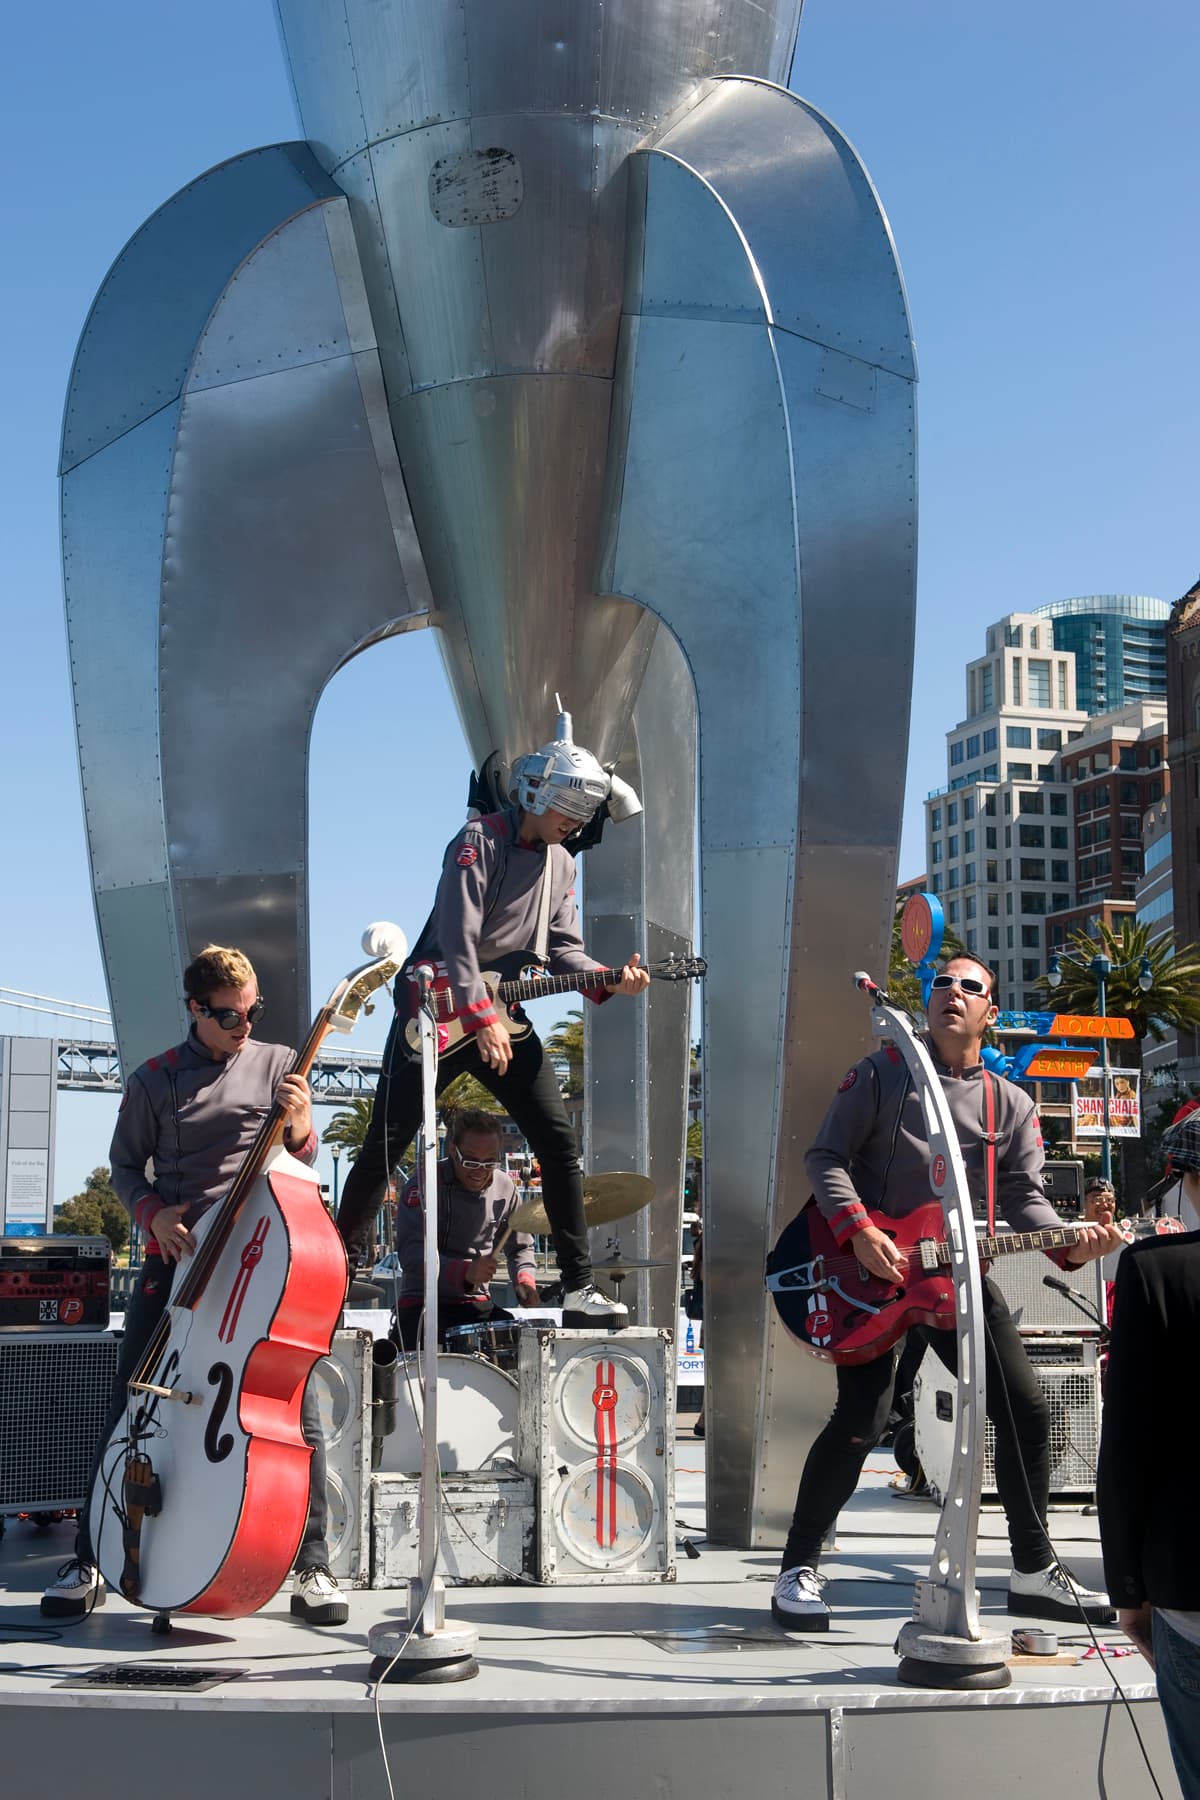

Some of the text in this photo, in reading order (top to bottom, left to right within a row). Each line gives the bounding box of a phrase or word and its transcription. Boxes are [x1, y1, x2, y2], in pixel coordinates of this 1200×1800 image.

[1056, 1017, 1125, 1035] LOCAL
[1038, 1056, 1085, 1072] EARTH
[1076, 1098, 1132, 1115] SHANGHAI
[245, 1245, 261, 1262] P
[63, 1301, 80, 1319] P
[812, 1314, 829, 1333] P
[598, 1389, 614, 1406] P
